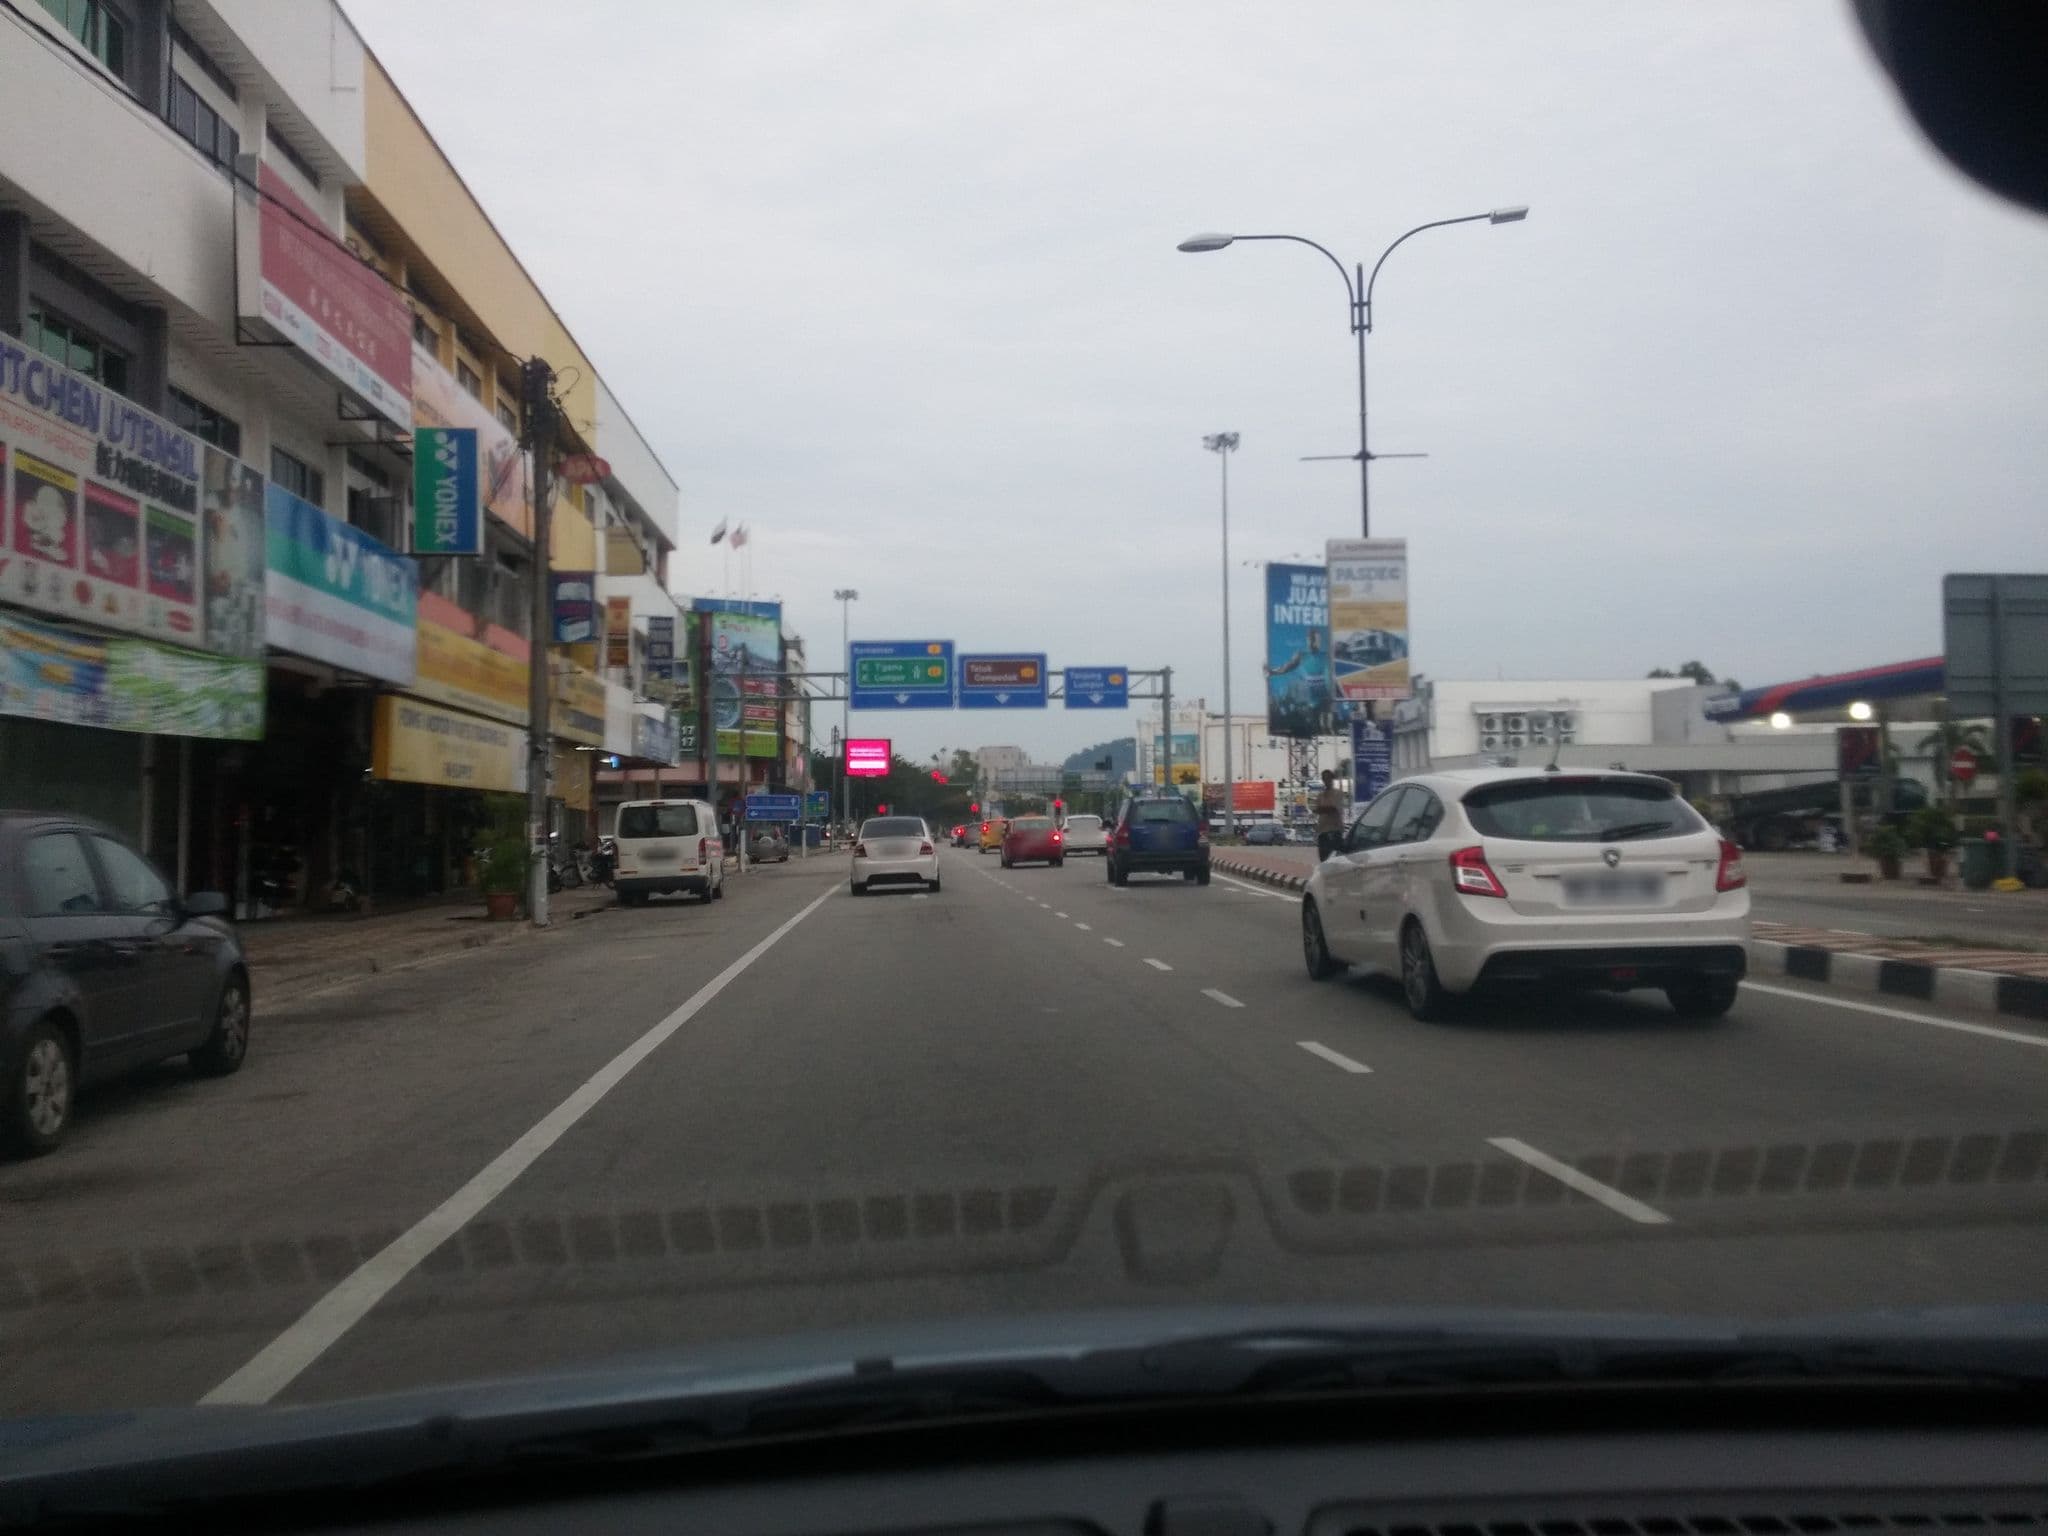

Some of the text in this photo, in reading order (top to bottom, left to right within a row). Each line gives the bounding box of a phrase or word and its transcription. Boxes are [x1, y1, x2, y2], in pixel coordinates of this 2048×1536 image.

[106, 399, 199, 482] UTENSIL
[435, 478, 458, 545] YONEX
[1274, 604, 1328, 626] INTER
